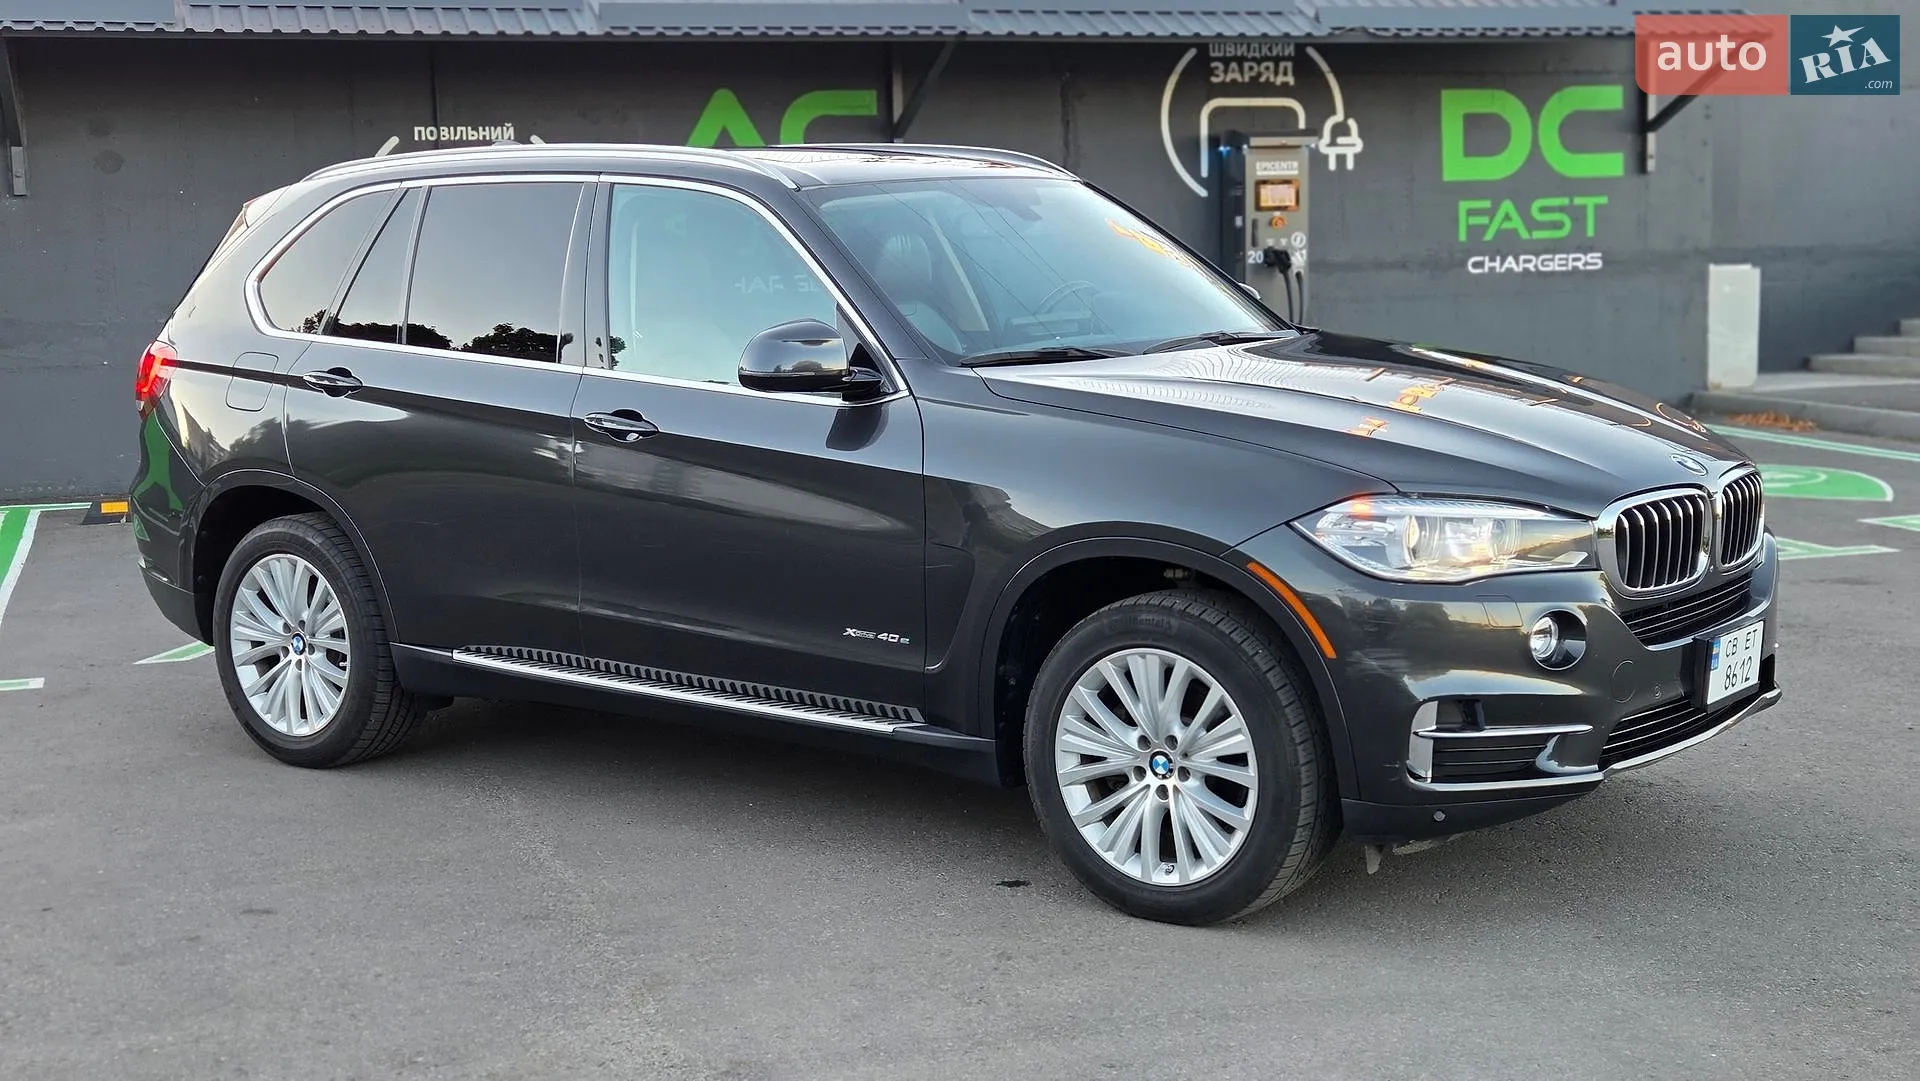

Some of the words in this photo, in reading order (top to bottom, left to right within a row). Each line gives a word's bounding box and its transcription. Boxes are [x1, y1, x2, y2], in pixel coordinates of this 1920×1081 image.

[1210, 61, 1295, 86] ЗАРЯД
[413, 122, 515, 141] ПОВІЛЬНИЙ
[1441, 84, 1624, 182] DC
[1458, 196, 1608, 242] FAST
[1467, 252, 1603, 273] CHARGERS
[1745, 629, 1757, 650] ET
[1724, 656, 1752, 690] 8612
